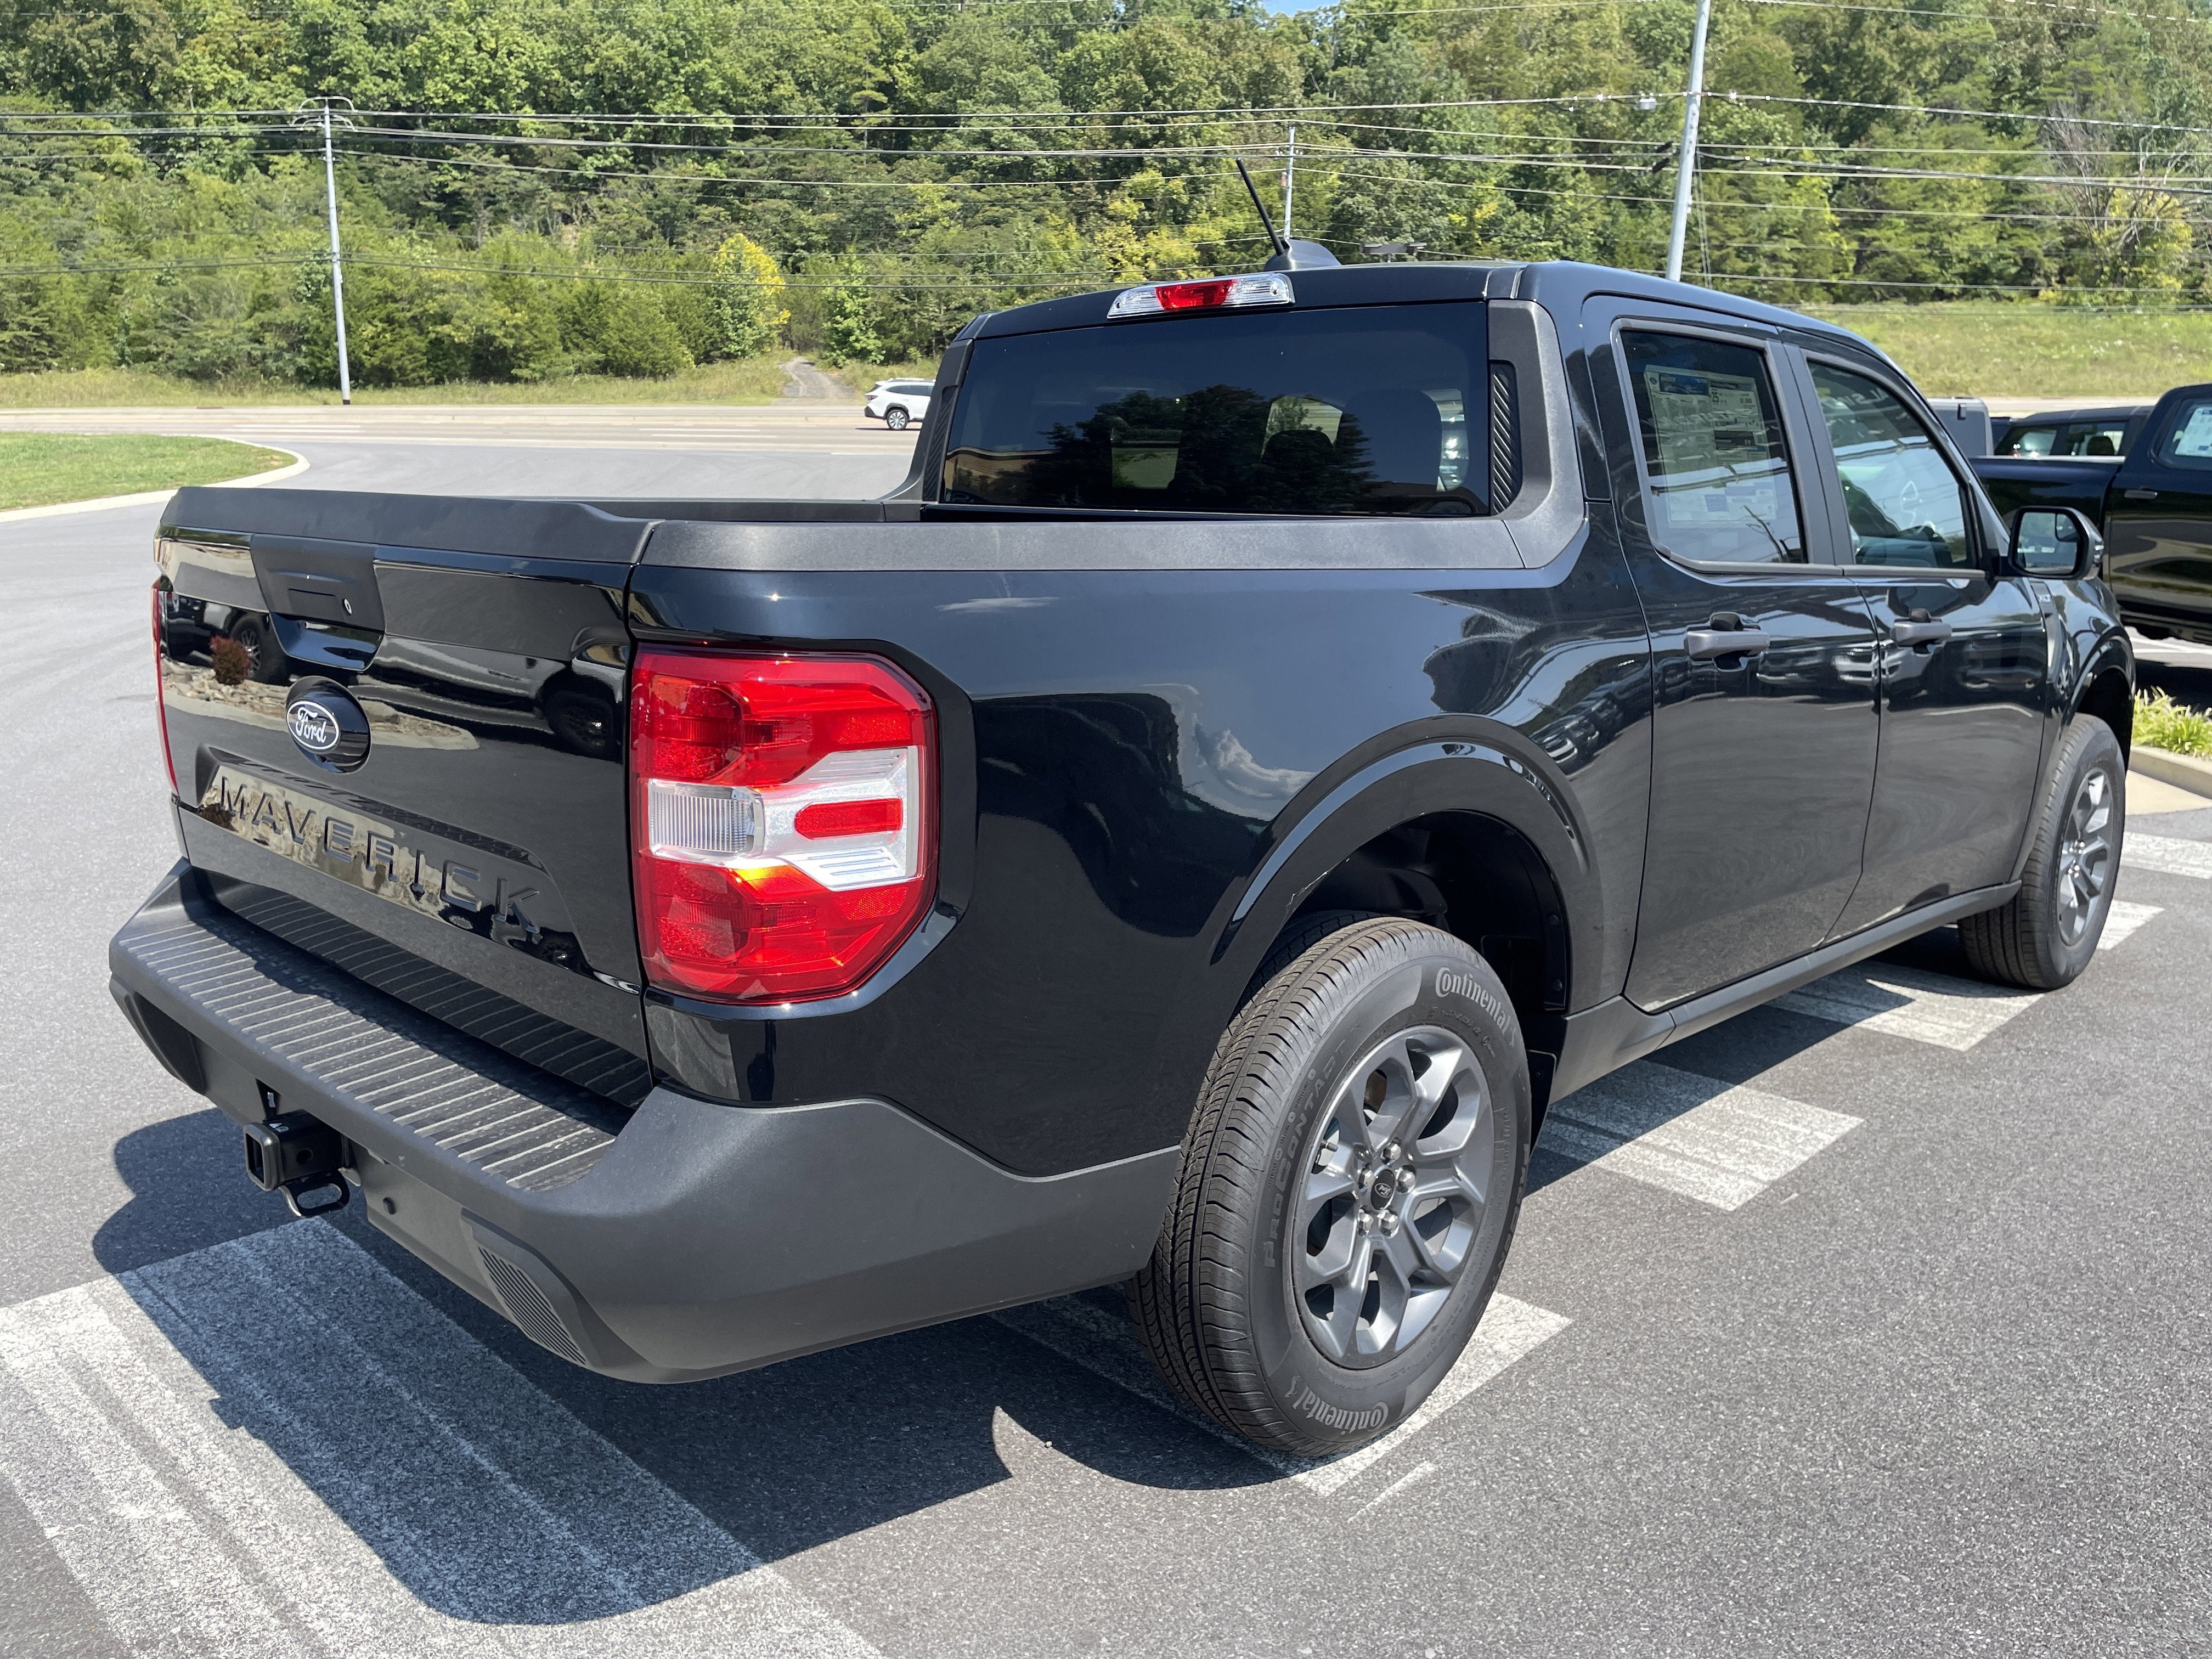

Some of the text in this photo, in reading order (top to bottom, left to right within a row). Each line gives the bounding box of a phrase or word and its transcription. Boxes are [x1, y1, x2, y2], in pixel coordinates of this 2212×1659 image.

[295, 707, 326, 743] Ford
[221, 776, 540, 934] MAVERICK
[1435, 967, 1511, 1036] Continental
[1292, 1385, 1389, 1435] Continental
